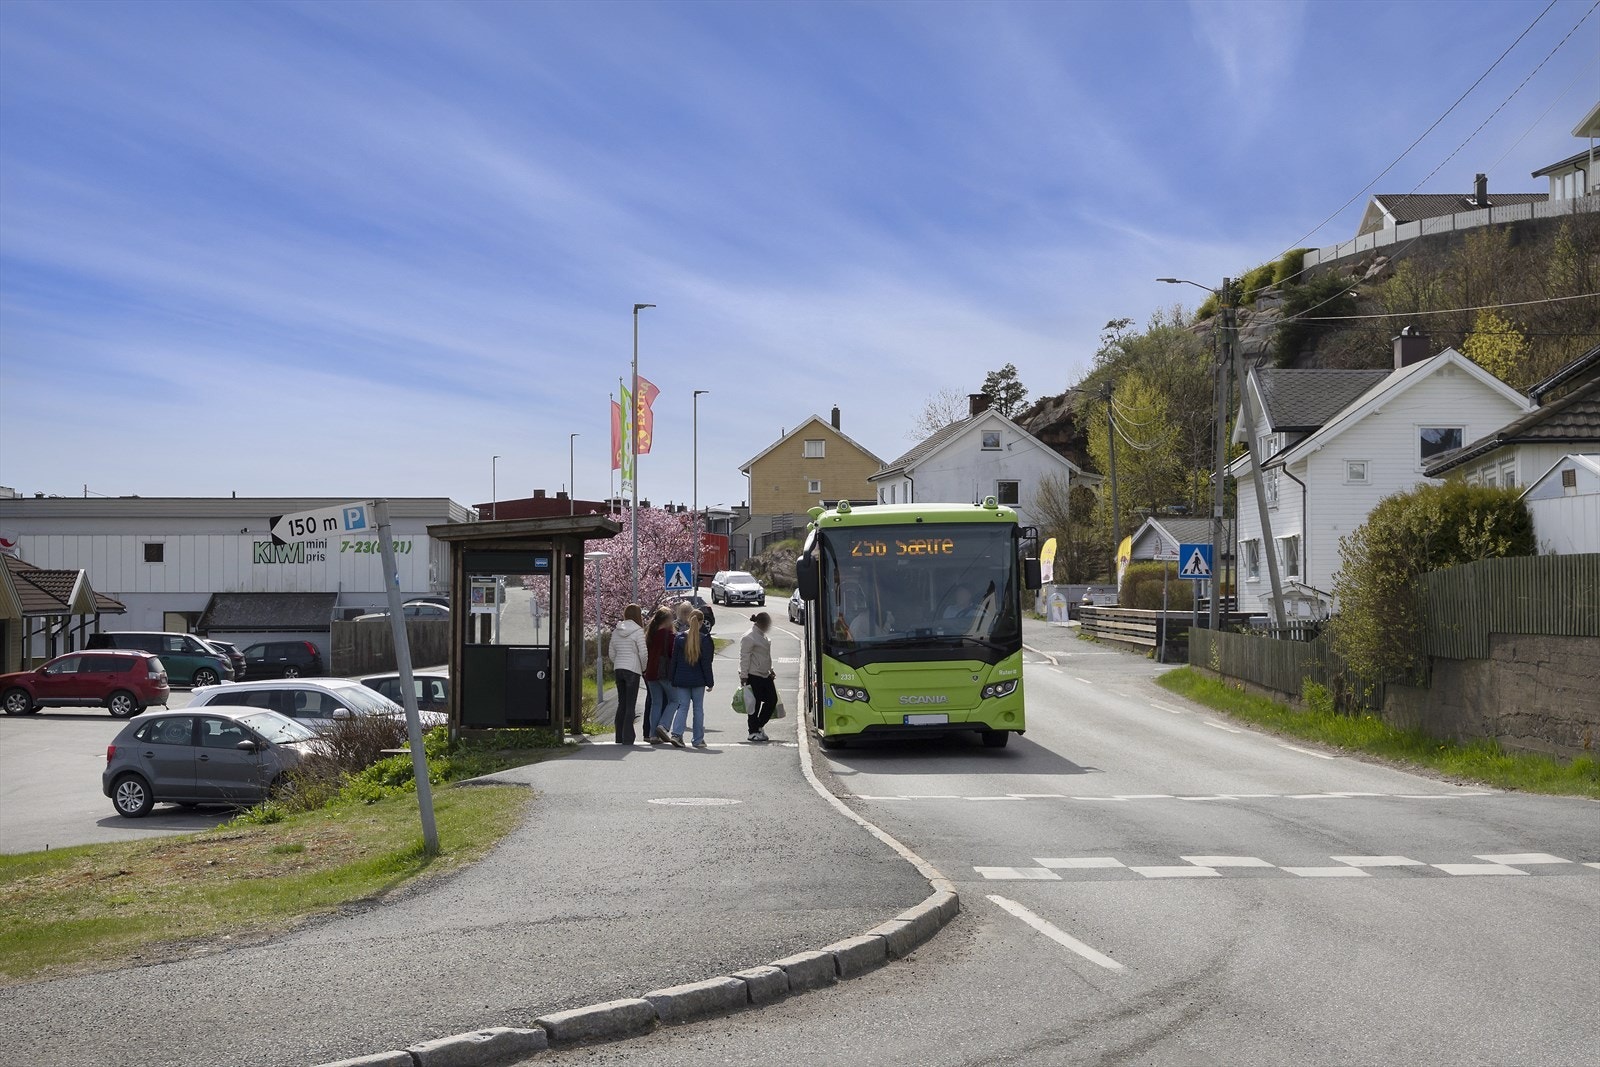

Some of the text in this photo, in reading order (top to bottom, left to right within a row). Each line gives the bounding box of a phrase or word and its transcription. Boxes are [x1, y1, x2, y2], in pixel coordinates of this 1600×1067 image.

[637, 382, 650, 426] EXTRA
[288, 508, 361, 537] 150 m P
[306, 538, 328, 549] mini
[895, 538, 954, 556] Sætre
[253, 540, 305, 564] KIWI
[306, 552, 326, 564] pris
[840, 673, 855, 681] 2331
[899, 695, 949, 705] SCANIA
